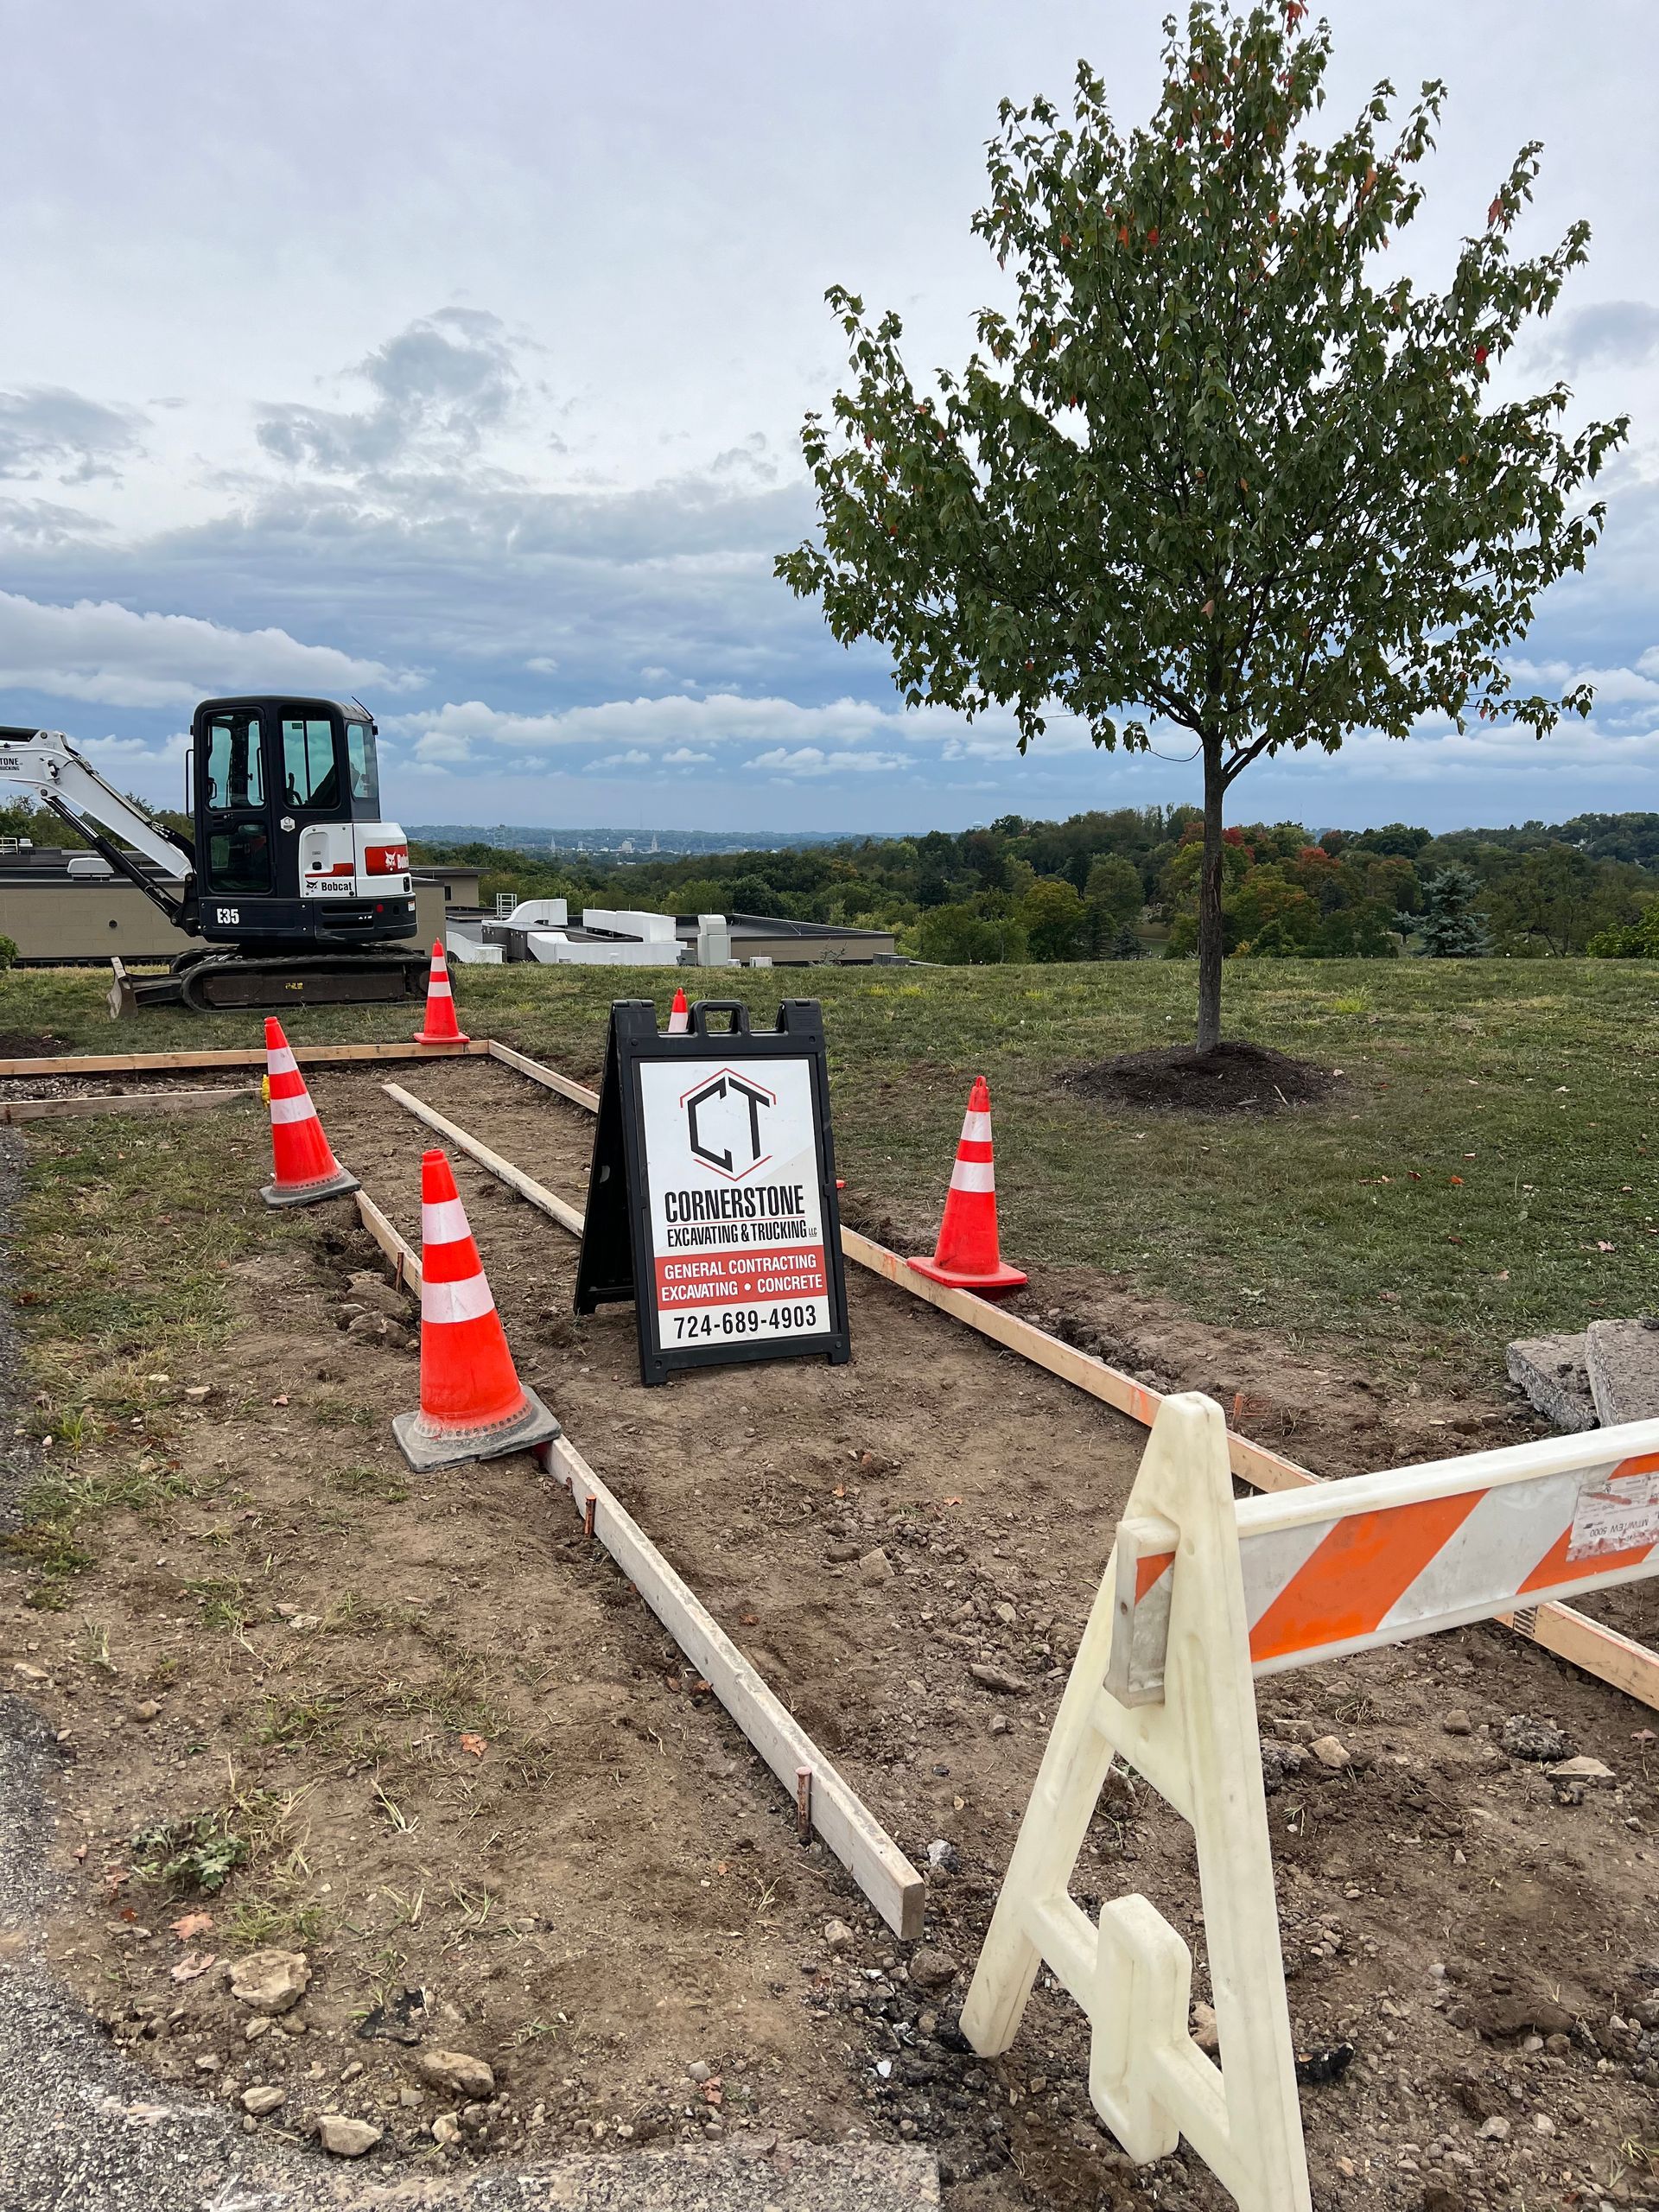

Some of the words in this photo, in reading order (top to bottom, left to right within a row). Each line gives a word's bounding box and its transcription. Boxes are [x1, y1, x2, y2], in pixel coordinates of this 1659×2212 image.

[321, 881, 353, 891] Bobcat
[216, 908, 239, 924] E35
[664, 1185, 805, 1223] CORNERSTONE
[667, 1224, 738, 1248] EXCAVATING
[741, 1223, 750, 1243] &
[751, 1219, 807, 1242] TRUCKING
[809, 1227, 817, 1236] LLC
[664, 1260, 726, 1280] GENERAL
[728, 1254, 817, 1274] CONTRACTING
[661, 1281, 738, 1302] EXCAVATING
[757, 1274, 823, 1294] CONCRETE
[673, 1305, 817, 1339] 724-689-4903
[1590, 1526, 1607, 1537] 5000
